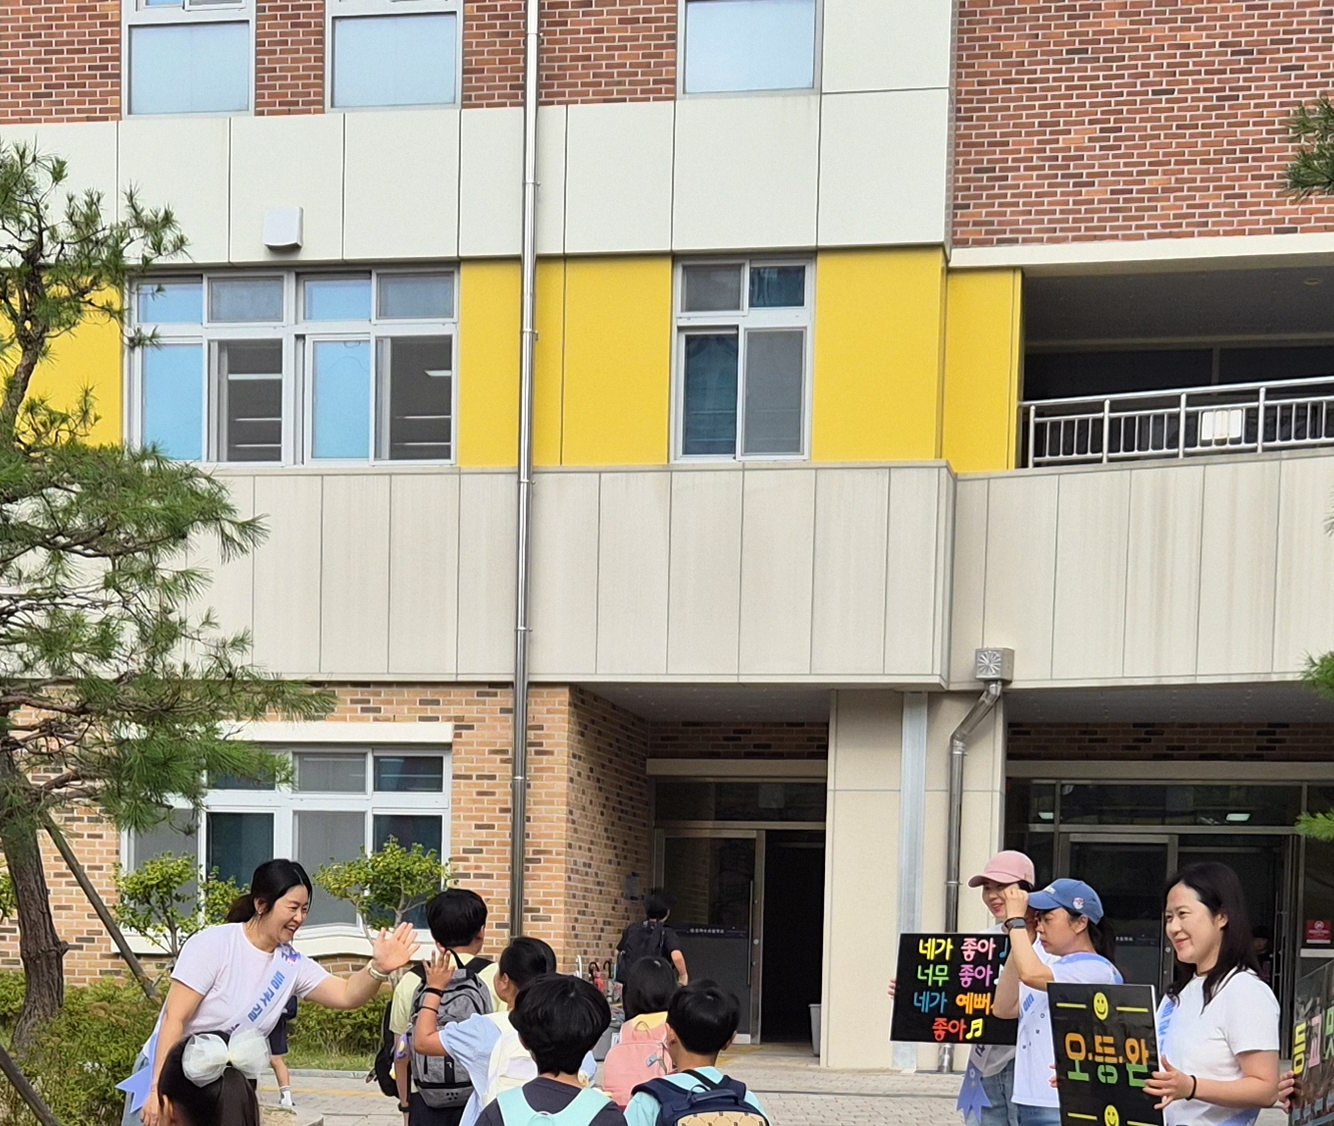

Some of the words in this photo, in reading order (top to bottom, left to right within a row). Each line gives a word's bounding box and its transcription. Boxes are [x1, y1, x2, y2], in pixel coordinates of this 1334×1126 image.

[918, 937, 953, 960] 네가
[960, 937, 996, 961] 좋아
[917, 964, 949, 987] 너무
[958, 964, 994, 988] 좋아
[913, 991, 947, 1013] 네가
[932, 1017, 967, 1041] 좋아
[1293, 1014, 1322, 1075] 등교
